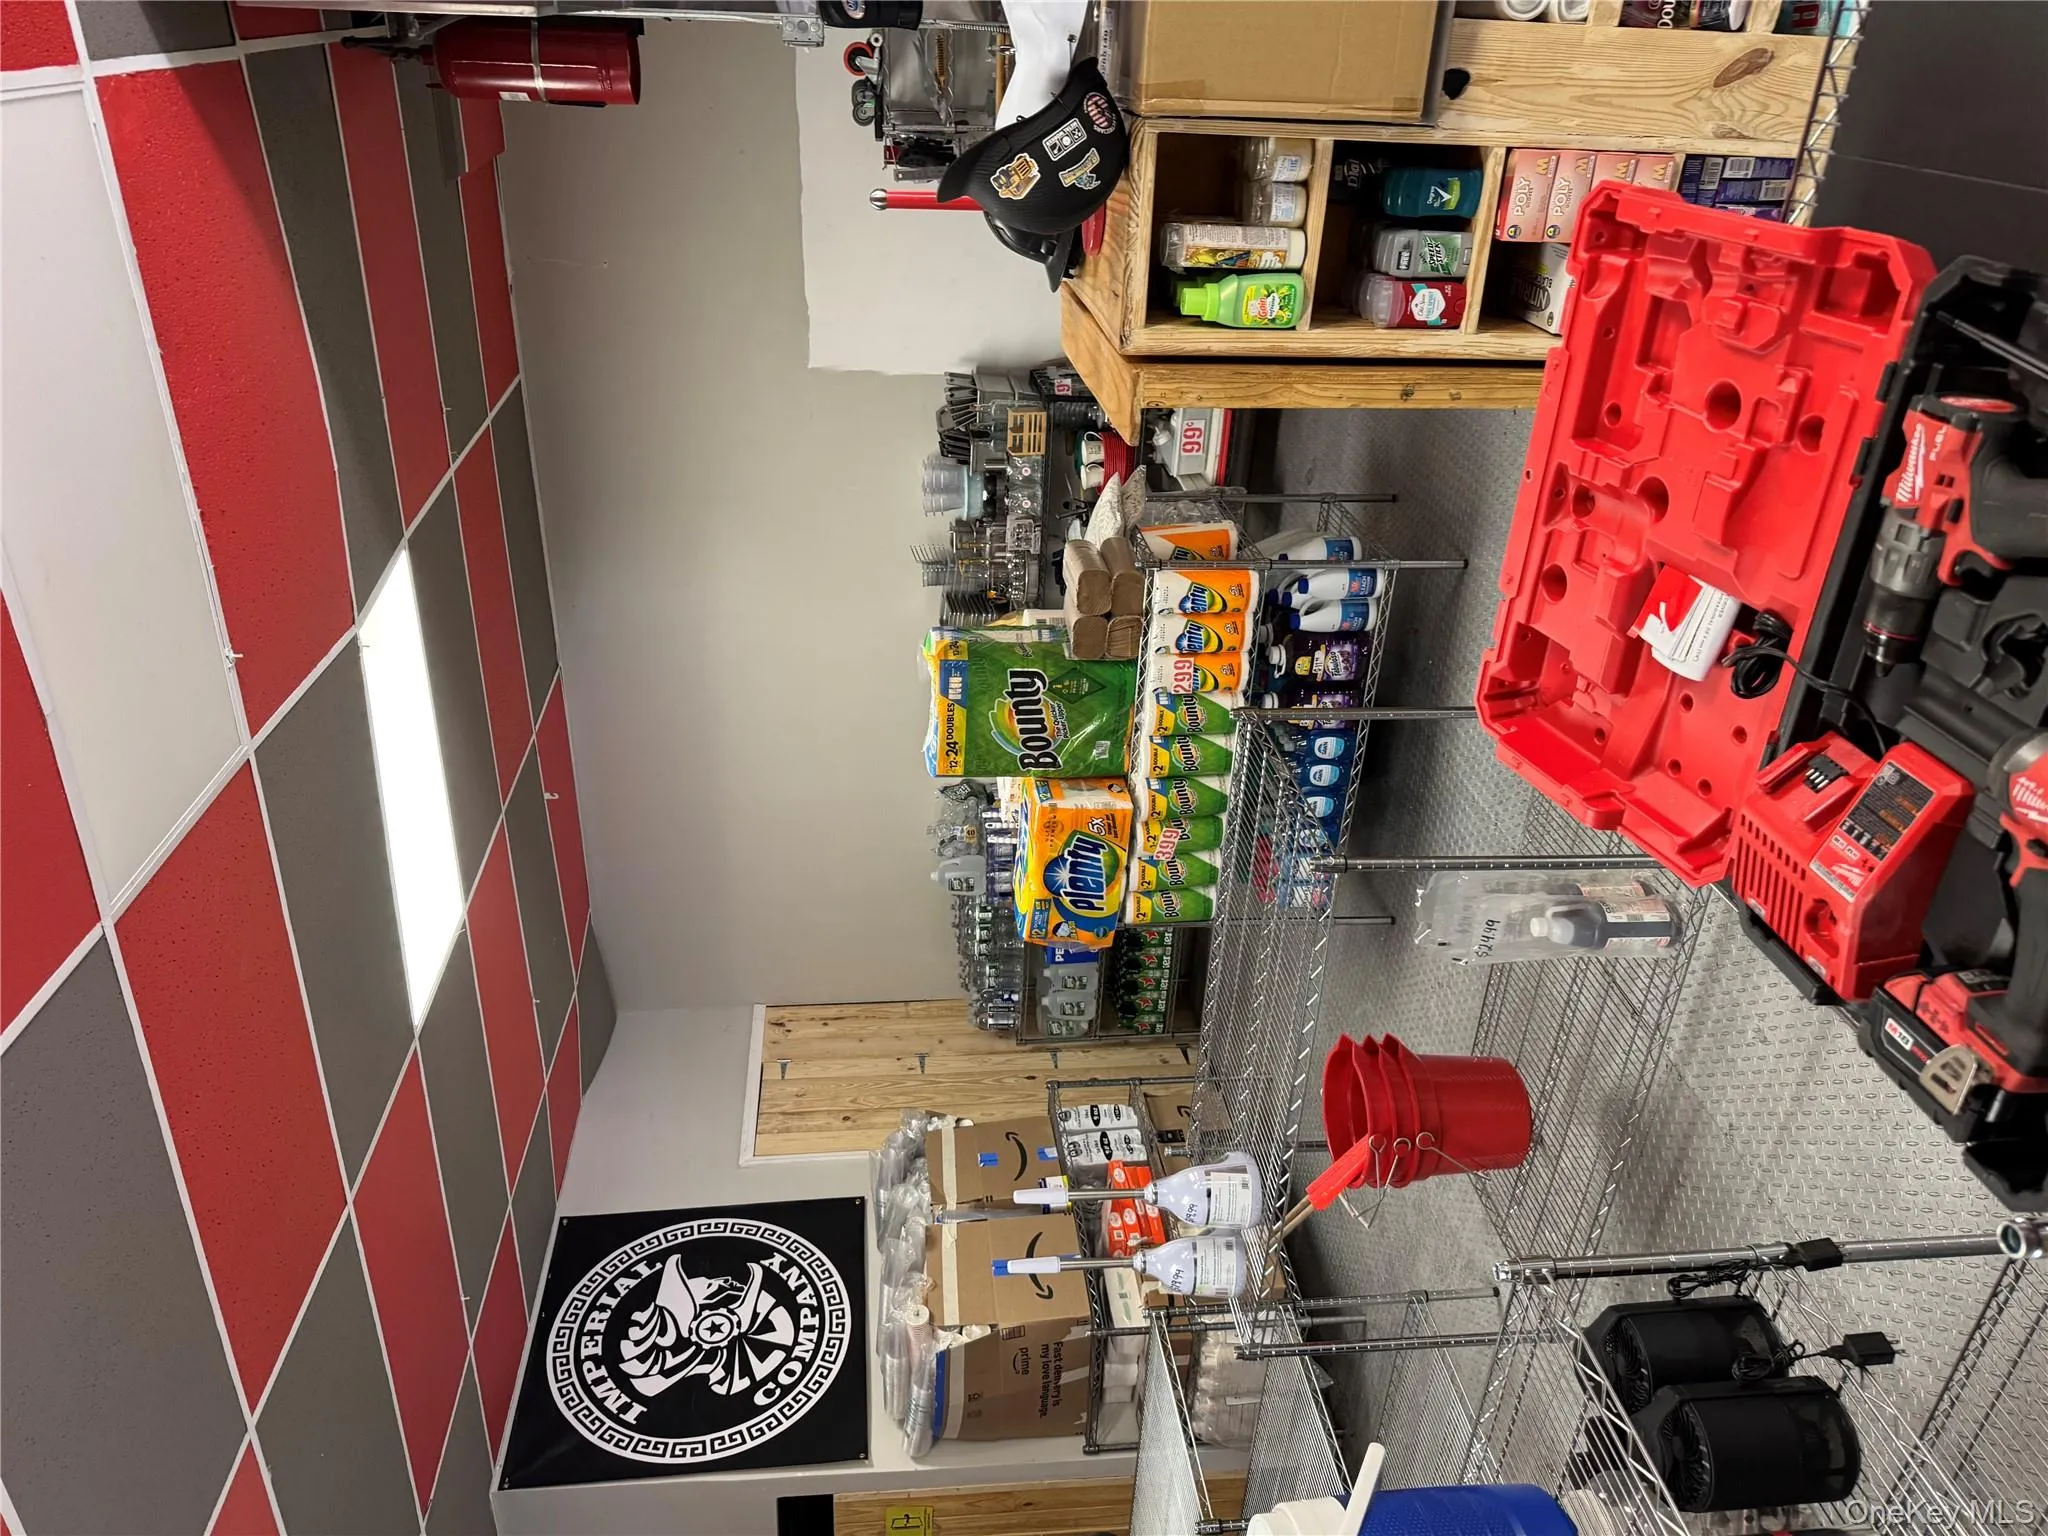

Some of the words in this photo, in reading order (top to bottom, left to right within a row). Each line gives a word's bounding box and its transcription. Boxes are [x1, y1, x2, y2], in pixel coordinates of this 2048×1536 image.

[1514, 177, 1530, 216] POLY
[1552, 178, 1572, 216] POLY
[1427, 242, 1436, 266] SPEED
[1434, 242, 1444, 264] STICK
[1929, 425, 1948, 461] FUEL
[1896, 423, 1922, 502] Milwaukee
[946, 703, 956, 740] DOUBLES
[1005, 669, 1061, 770] Bounty
[1050, 702, 1060, 725] Quicker
[1056, 702, 1066, 720] Upper
[1060, 720, 1069, 738] Picker
[1182, 696, 1202, 732] Bounty
[1055, 726, 1063, 737] The
[1172, 778, 1194, 815] Bounty
[1062, 836, 1107, 911] Plenty
[580, 1261, 662, 1424] IMPERIAL
[760, 1252, 820, 1406] COMPANY
[1018, 1347, 1031, 1375] prime
[1040, 1344, 1049, 1358] my
[1054, 1342, 1063, 1363] Fast
[1042, 1360, 1051, 1380] love
